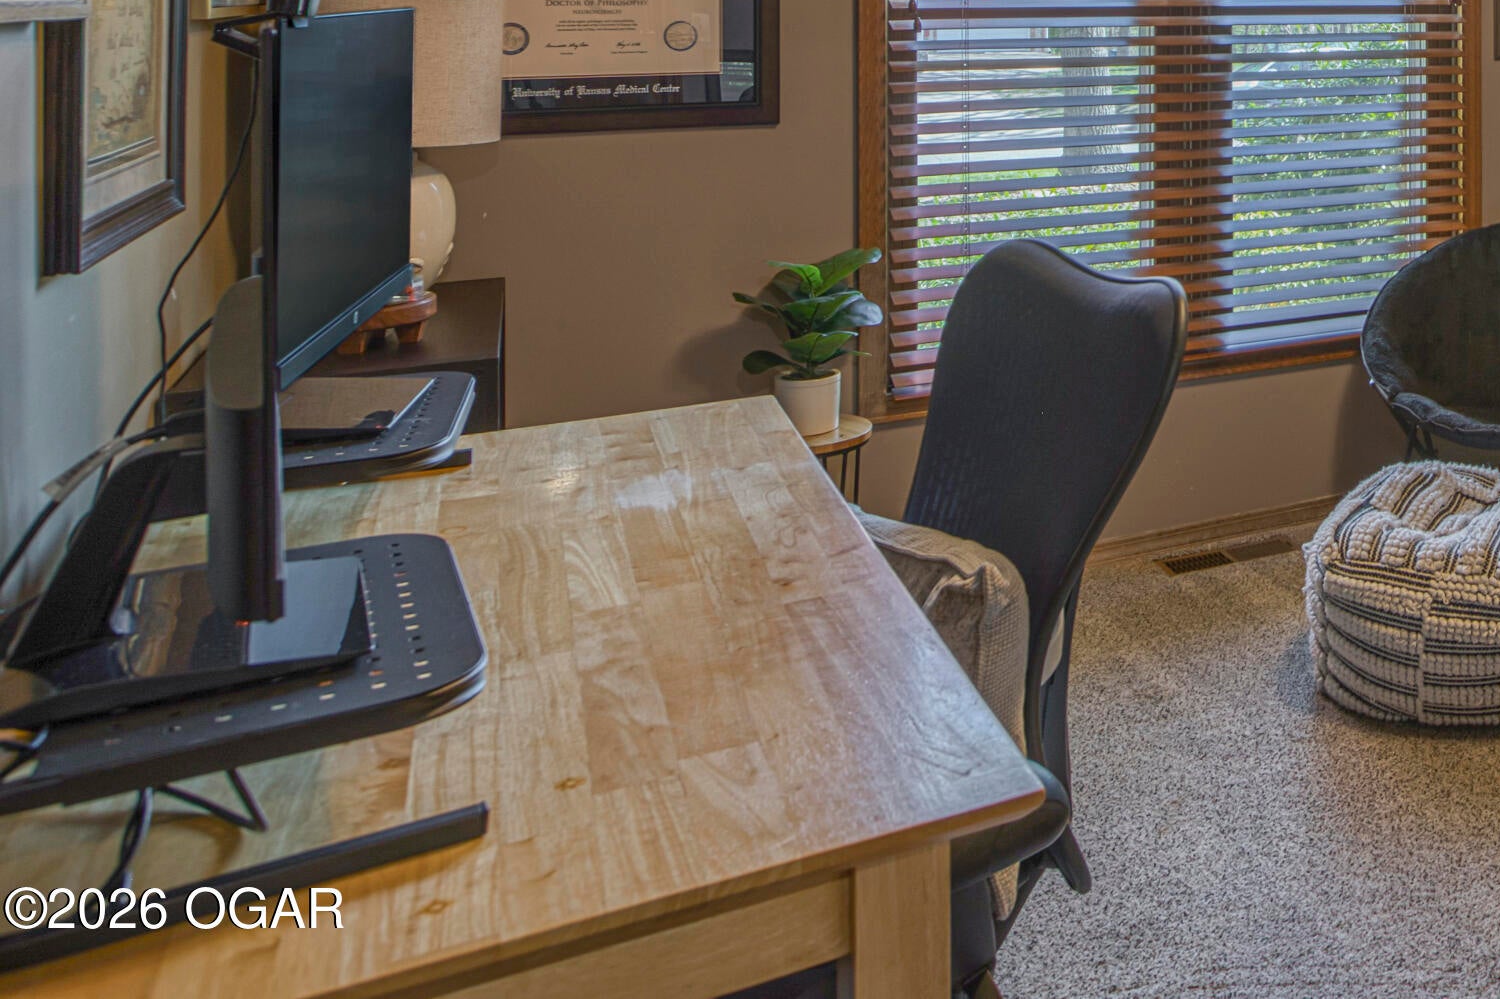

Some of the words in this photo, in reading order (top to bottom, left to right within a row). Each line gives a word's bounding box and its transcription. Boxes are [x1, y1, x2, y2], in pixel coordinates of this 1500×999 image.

[512, 87, 560, 100] University
[564, 87, 574, 97] of
[576, 86, 611, 98] Kansas
[614, 84, 649, 96] Medical
[652, 84, 680, 94] Center
